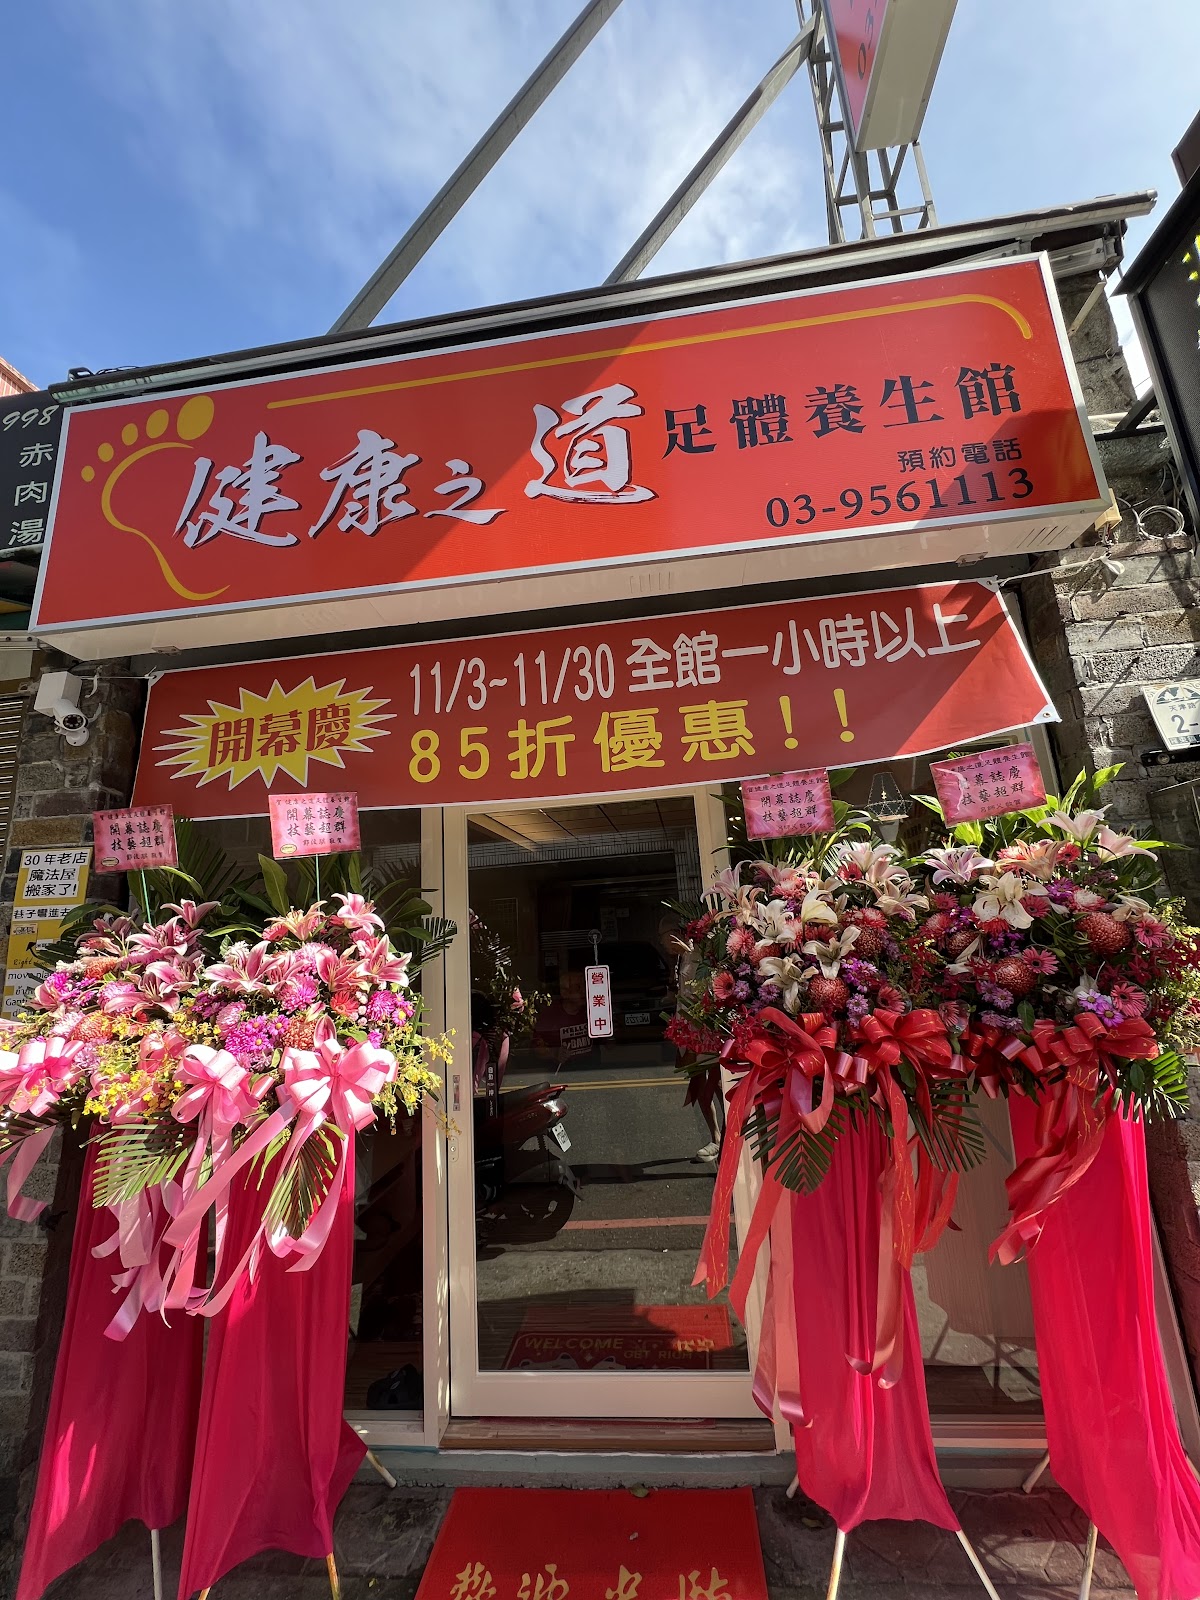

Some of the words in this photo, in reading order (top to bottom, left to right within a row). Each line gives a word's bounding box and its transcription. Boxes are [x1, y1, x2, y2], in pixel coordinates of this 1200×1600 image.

[2, 404, 60, 432] 998
[172, 383, 657, 549] 健康之道
[662, 362, 1023, 460] 足體養生館
[897, 437, 1023, 473] 預約電話
[8, 442, 54, 545] 赤肉湯
[766, 467, 1034, 527] 03-9561113
[208, 703, 351, 768] 開幕慶
[958, 765, 1022, 791] 幕誌慶
[28, 868, 77, 883] 魔法屋
[590, 971, 607, 1031] 營業中
[525, 1337, 625, 1350] WELCOME
[623, 1350, 650, 1360] GET
